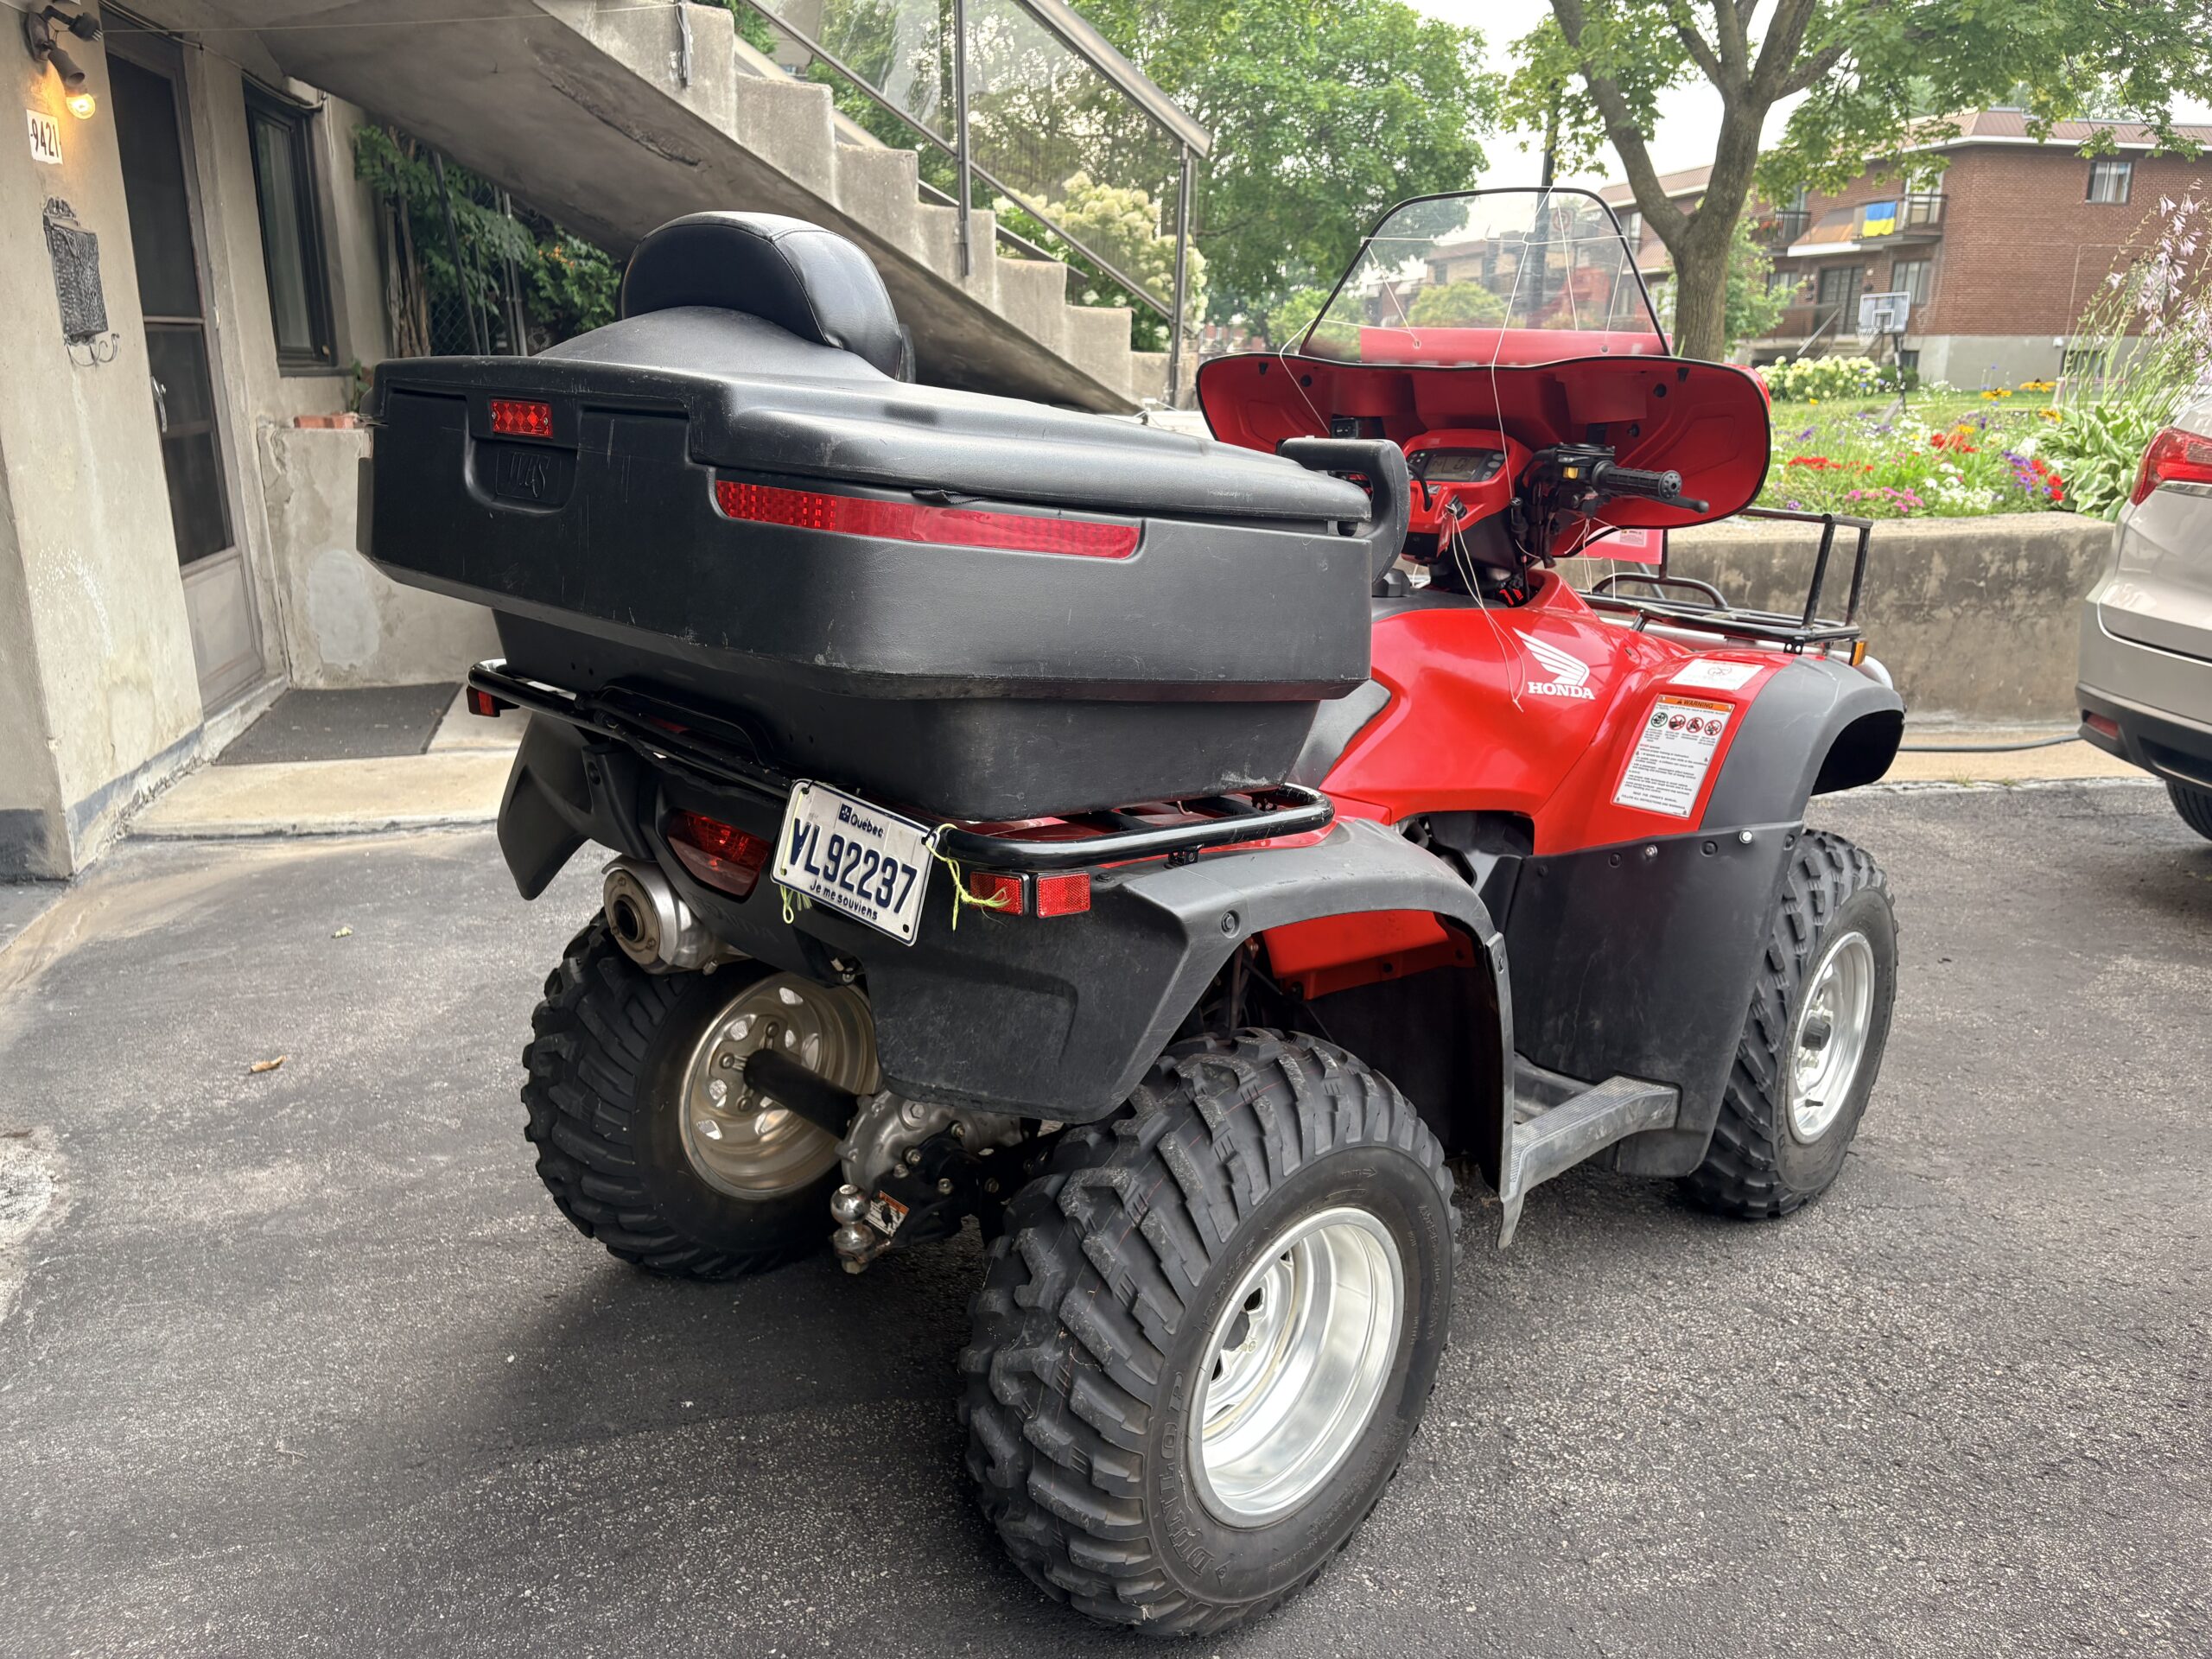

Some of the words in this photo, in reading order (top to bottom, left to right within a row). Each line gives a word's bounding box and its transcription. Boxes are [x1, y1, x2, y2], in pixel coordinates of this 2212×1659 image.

[32, 118, 59, 157] 9421
[1527, 681, 1596, 700] HONDA
[1683, 699, 1713, 709] WARNING
[850, 813, 883, 838] Québec
[789, 818, 918, 914] VL92237
[810, 880, 822, 893] Je
[823, 887, 836, 899] me
[837, 893, 878, 920] souviens
[1159, 1370, 1215, 1578] DUNLOP
